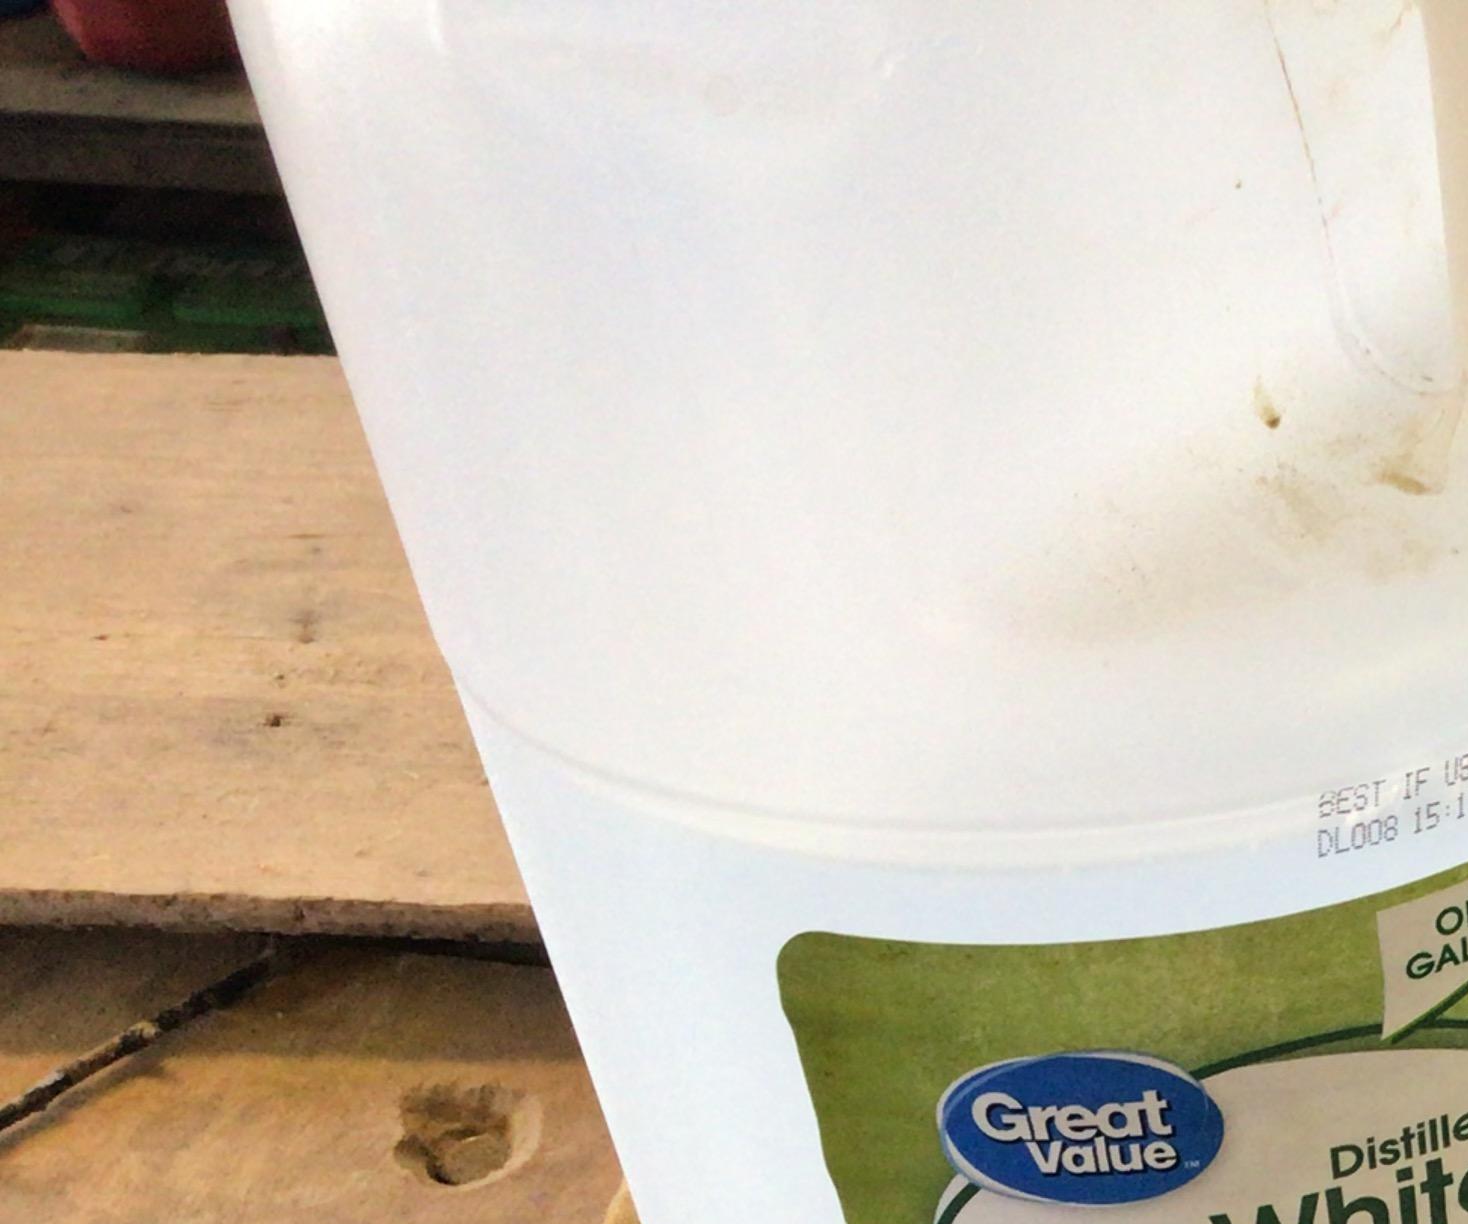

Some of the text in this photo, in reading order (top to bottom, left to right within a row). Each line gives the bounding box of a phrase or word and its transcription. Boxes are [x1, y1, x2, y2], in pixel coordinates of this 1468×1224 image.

[1319, 778, 1386, 819] BEST
[1403, 767, 1431, 800] IF
[970, 1088, 1173, 1143] Great
[1026, 1136, 1178, 1175] Value
